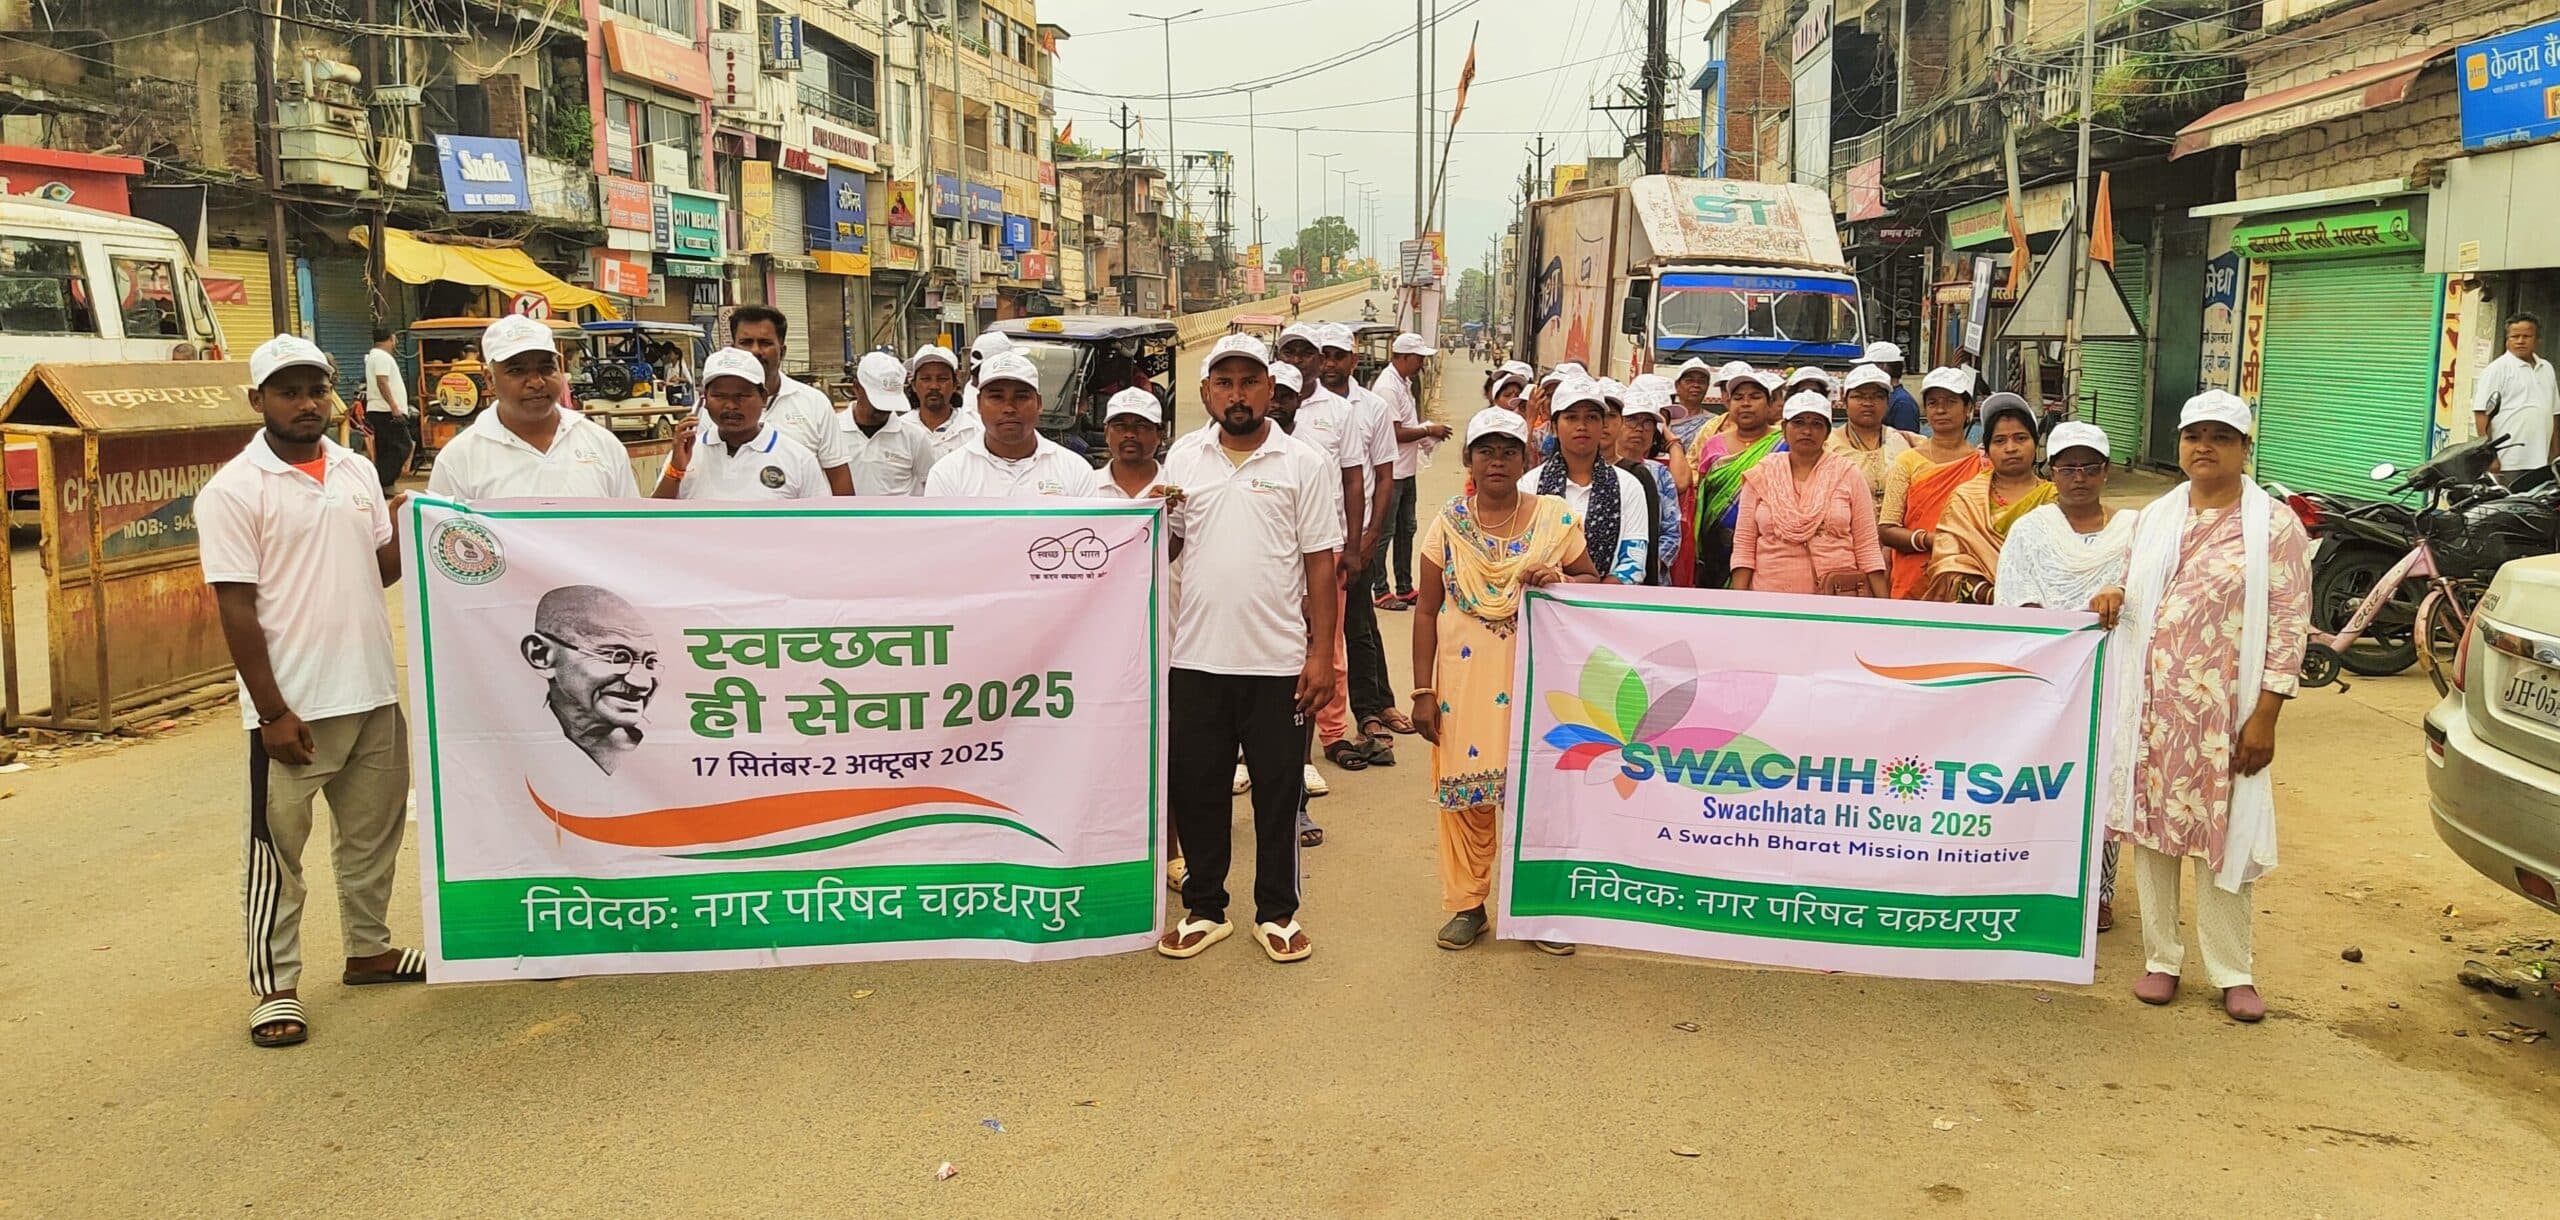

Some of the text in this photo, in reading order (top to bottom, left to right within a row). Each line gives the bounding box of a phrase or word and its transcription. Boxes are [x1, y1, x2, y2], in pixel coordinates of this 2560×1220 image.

[726, 51, 736, 104] STORE
[2491, 48, 2540, 79] केनरा
[675, 208, 691, 227] CITY
[1693, 194, 1777, 226] ST
[694, 283, 717, 303] ATM
[2205, 264, 2235, 299] मेधा
[63, 463, 225, 513] CHAKRADHARP
[1080, 550, 1100, 559] भारत
[683, 625, 954, 670] स्वच्छता
[685, 671, 1074, 739] ही सेवा 2025
[691, 756, 718, 777] 17
[846, 749, 933, 779] अक्टूबर
[941, 741, 1004, 766] 2025
[1703, 796, 1992, 837] Swachhata Hi Seva 2025
[1657, 827, 2030, 864] A Swachh Bharat Mission Initiative
[521, 876, 1086, 933] निवेदक: नगर परिषद चक्रधरपुर
[1568, 867, 2021, 941] निवेदक: नगर परिषद चक्रधरपुर
